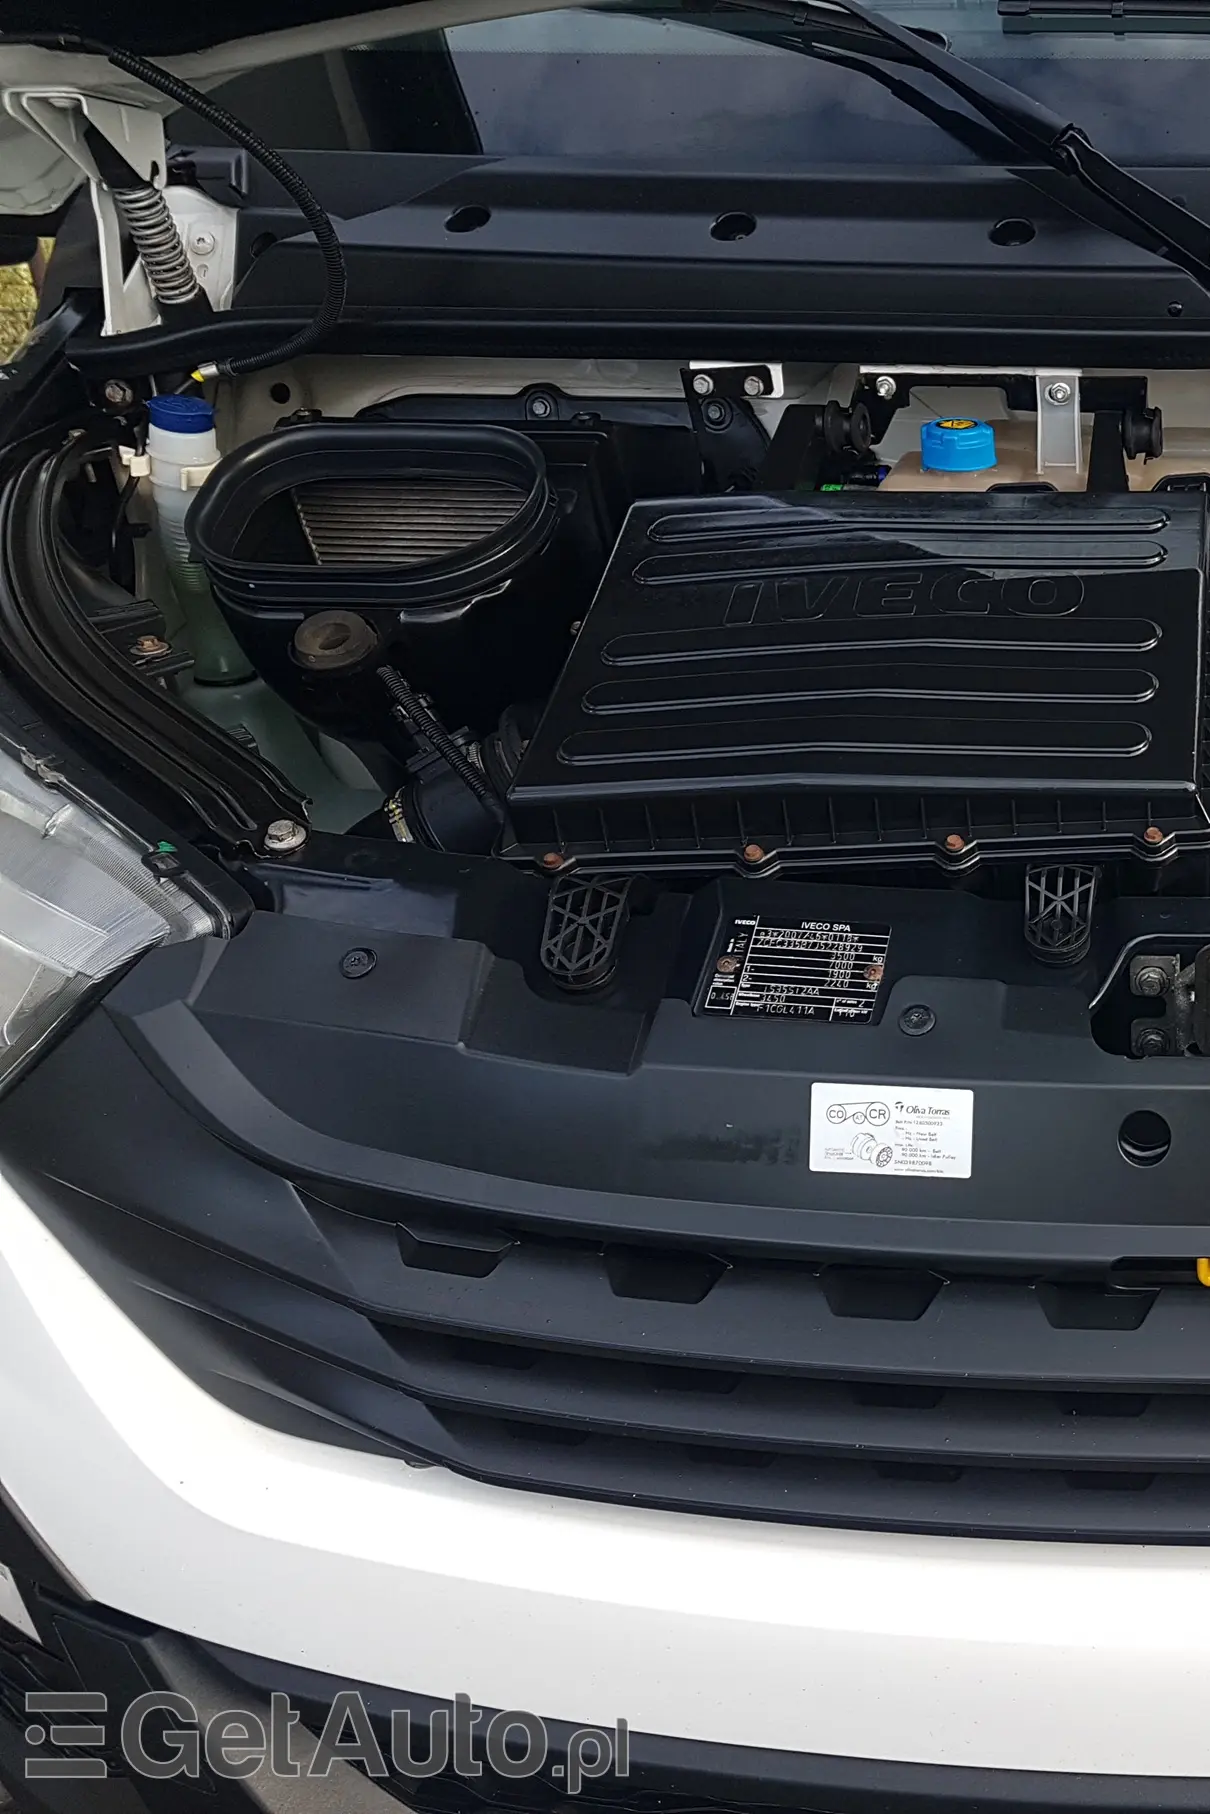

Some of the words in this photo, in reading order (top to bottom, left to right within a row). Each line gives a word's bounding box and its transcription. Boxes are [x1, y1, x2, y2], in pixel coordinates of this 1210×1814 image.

[723, 571, 1085, 627] IVECO
[801, 921, 831, 931] IVECO
[832, 923, 851, 932] SPA
[830, 952, 855, 961] 3500
[872, 955, 883, 963] kg
[829, 961, 853, 970] 7000
[828, 969, 852, 979] 1900
[743, 974, 752, 982] 2-
[823, 979, 849, 988] 2240
[829, 1109, 844, 1119] CO
[869, 1109, 886, 1119] CR
[906, 1105, 926, 1115] Oliva
[927, 1106, 950, 1116] Torras
